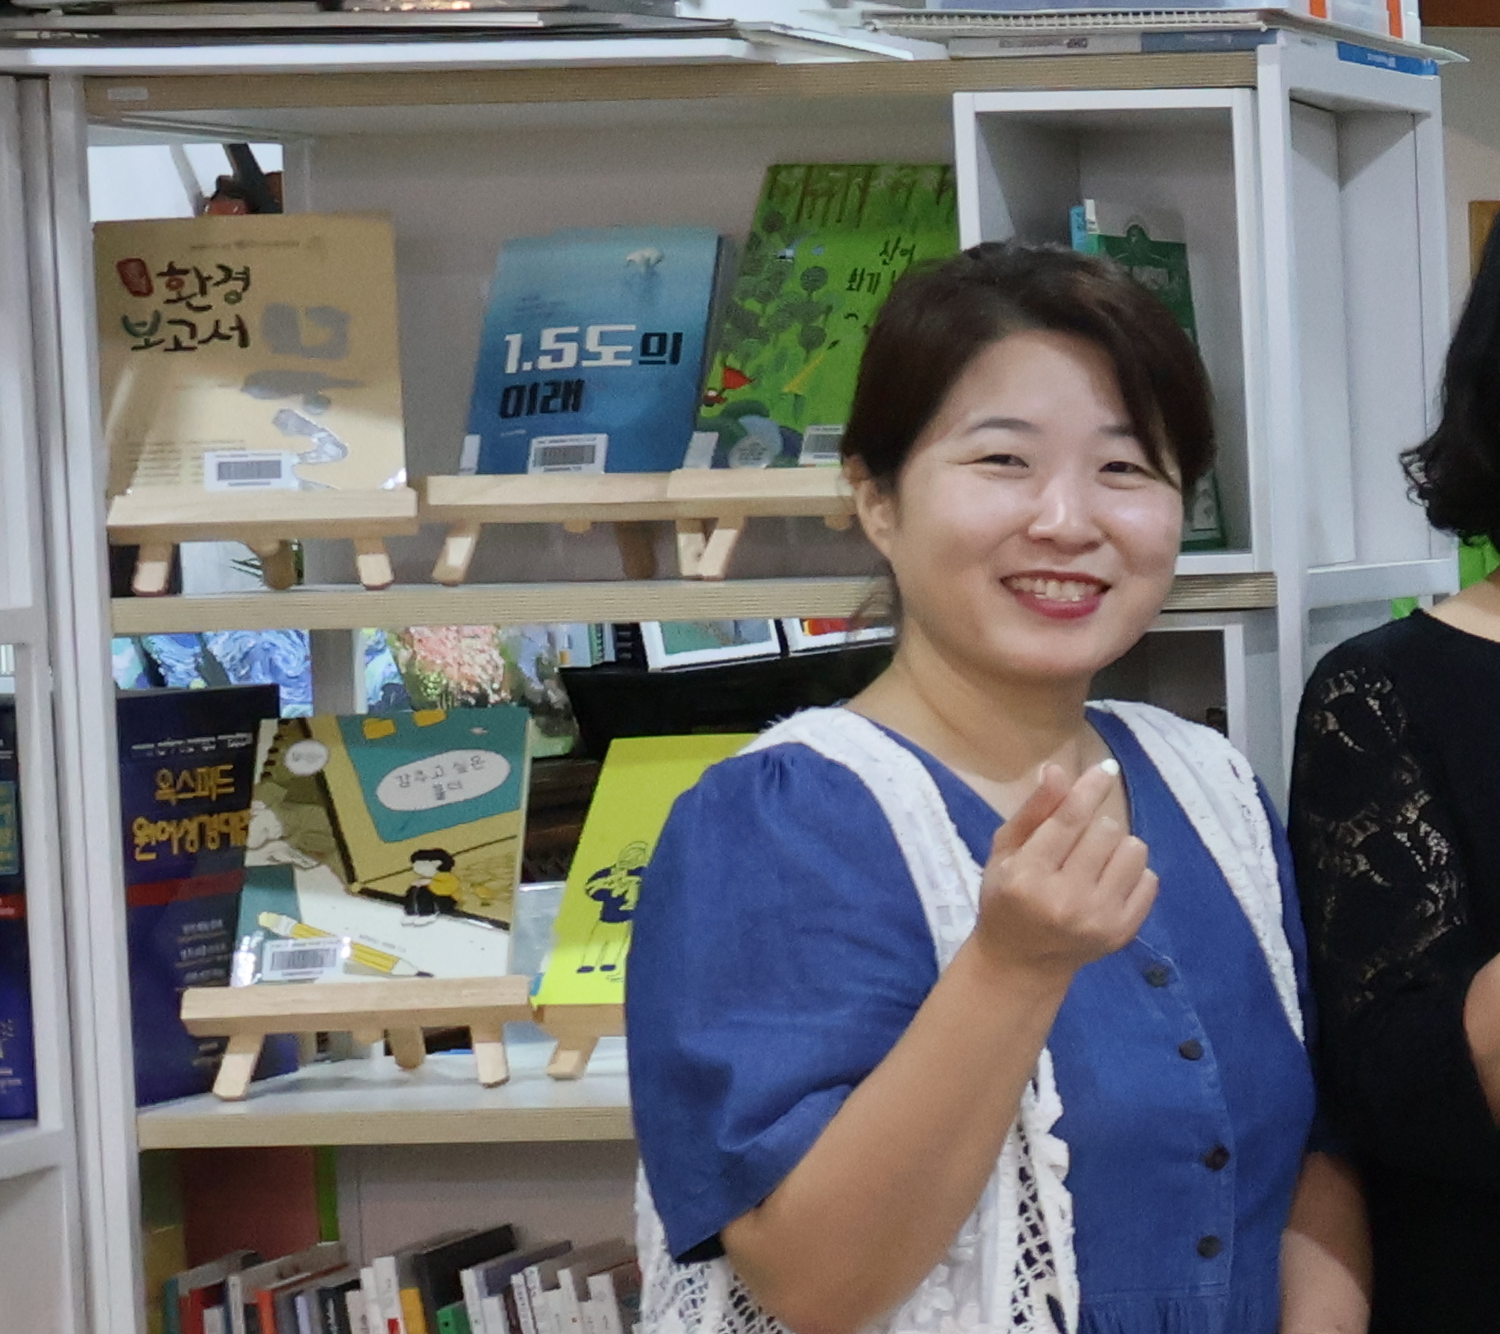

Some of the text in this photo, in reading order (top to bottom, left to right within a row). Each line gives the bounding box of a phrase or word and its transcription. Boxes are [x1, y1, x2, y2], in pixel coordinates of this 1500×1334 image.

[157, 261, 251, 312] 환경
[121, 309, 250, 353] 보고서
[504, 323, 683, 374] 1.5도의
[499, 378, 585, 418] 미래
